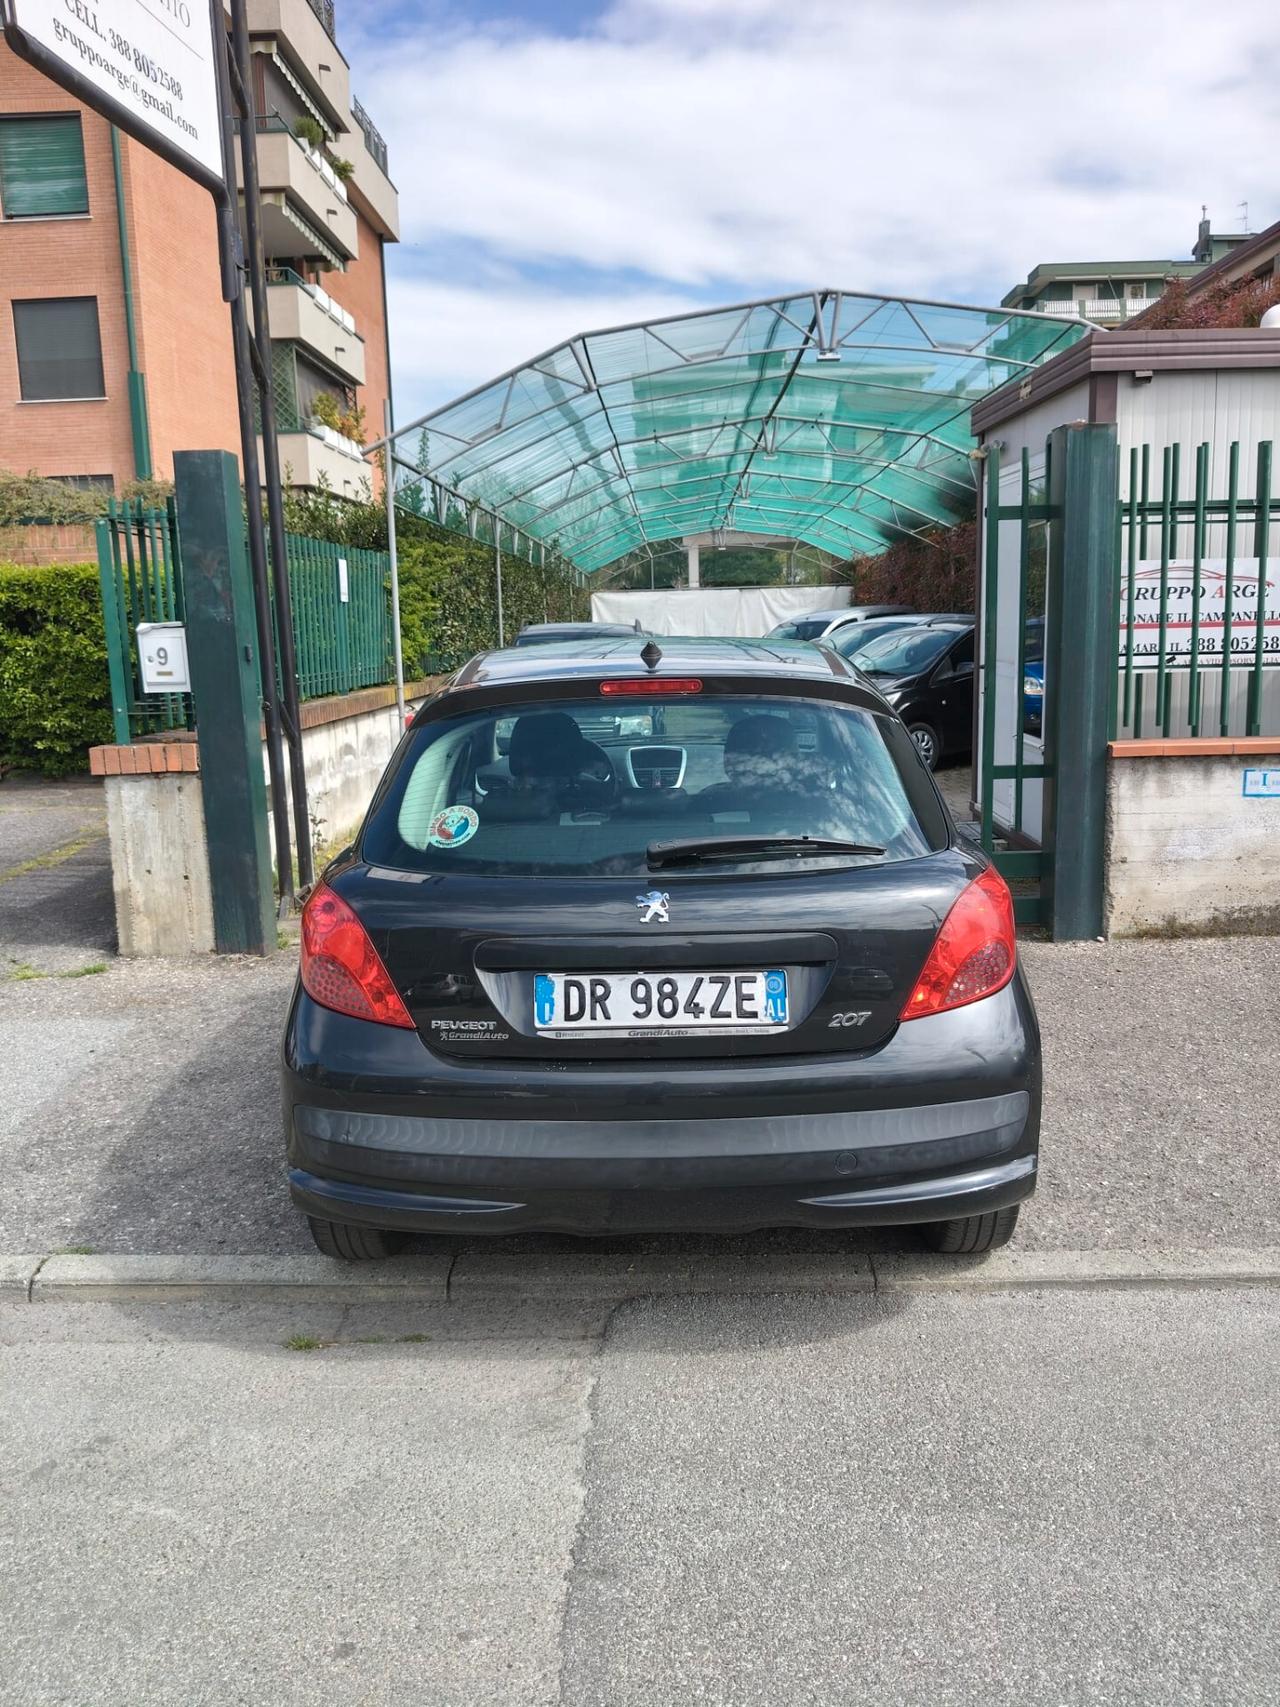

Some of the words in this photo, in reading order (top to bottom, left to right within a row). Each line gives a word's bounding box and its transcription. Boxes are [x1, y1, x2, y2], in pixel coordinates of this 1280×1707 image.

[109, 28, 132, 62] 388
[133, 47, 183, 101] 8052588
[52, 18, 199, 141] gruppoarge@gmail.com
[1178, 612, 1191, 623] IL
[1170, 642, 1183, 652] IL
[156, 647, 168, 666] 9
[563, 979, 611, 1022] DR
[631, 976, 758, 1019] 984ZE
[767, 998, 785, 1017] AL
[431, 1020, 497, 1030] PEUGEOT
[828, 1011, 872, 1027] 207
[448, 1031, 509, 1040] GrandiAuto
[628, 1029, 688, 1037] GrandiAuto
